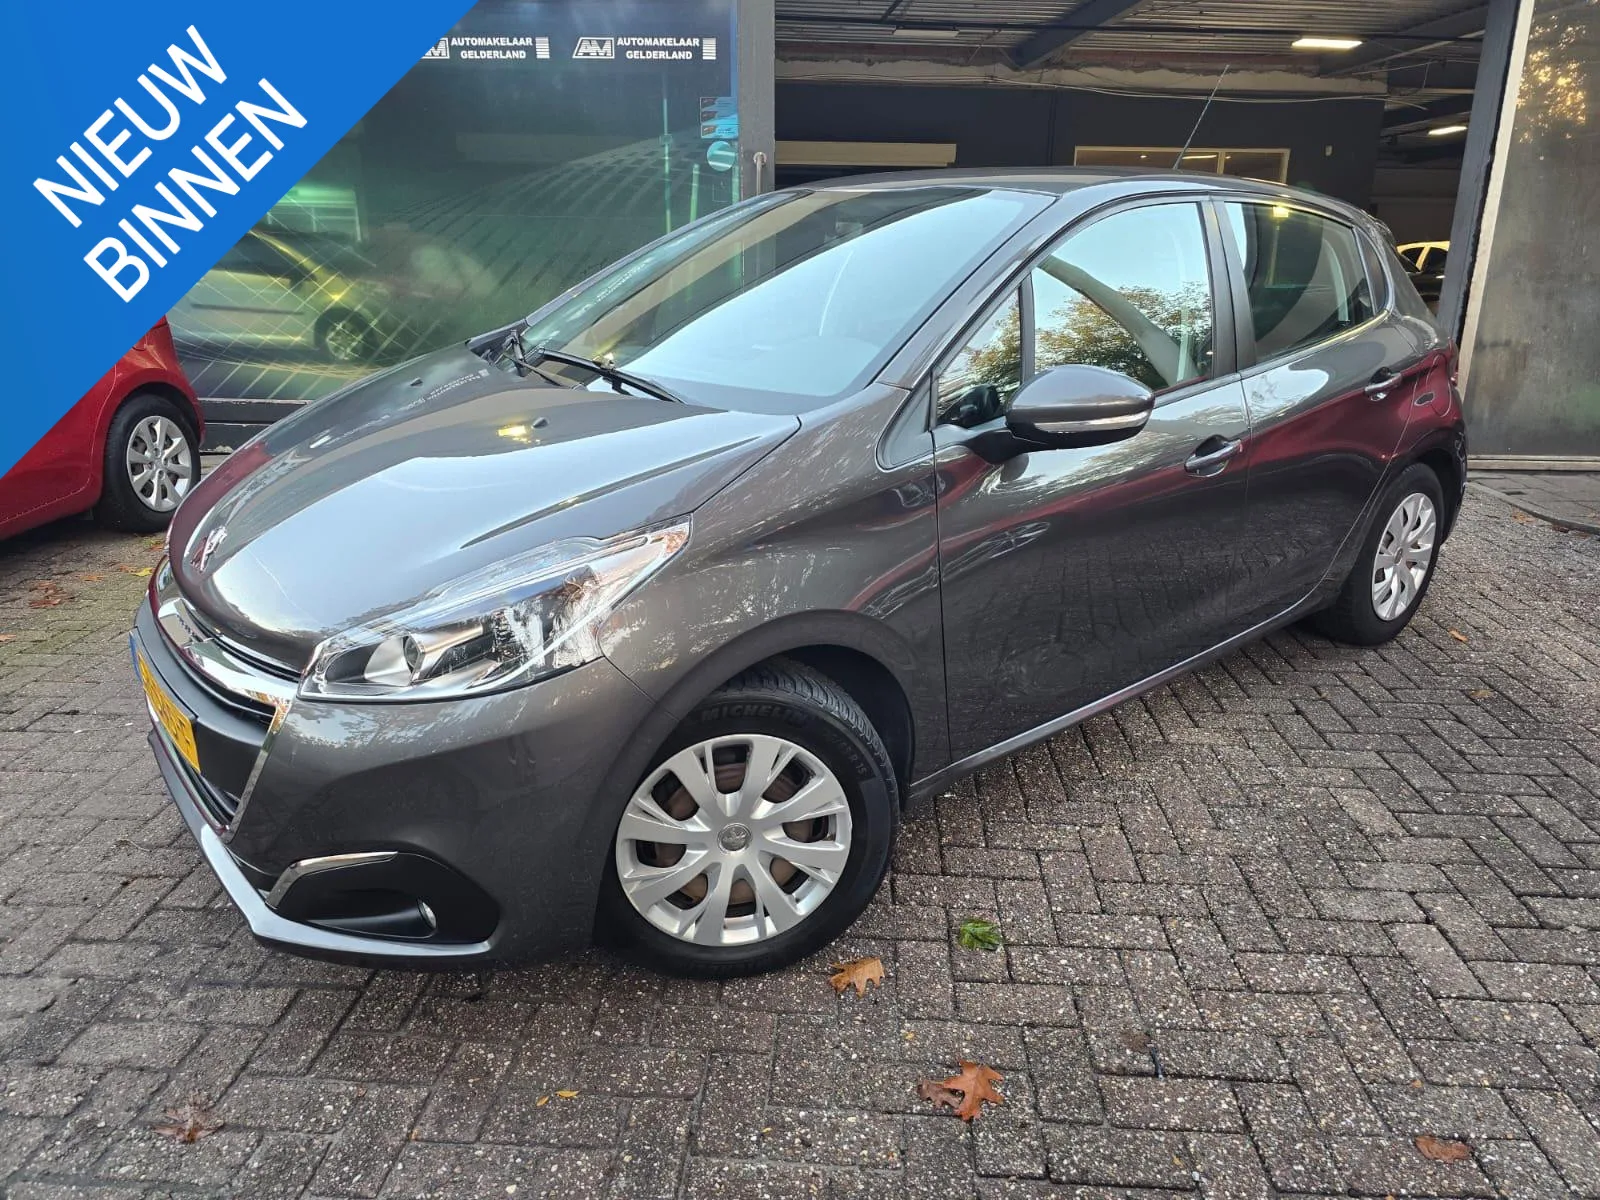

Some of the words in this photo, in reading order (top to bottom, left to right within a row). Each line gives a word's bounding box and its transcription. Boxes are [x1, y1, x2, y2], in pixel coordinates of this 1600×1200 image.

[450, 37, 533, 46] AUTOMAKELAAR
[616, 37, 700, 47] AUTOMAKELAAR
[460, 50, 527, 59] GELDERLAND
[625, 50, 693, 60] GELDERLAND
[701, 704, 808, 727] MICHELIN
